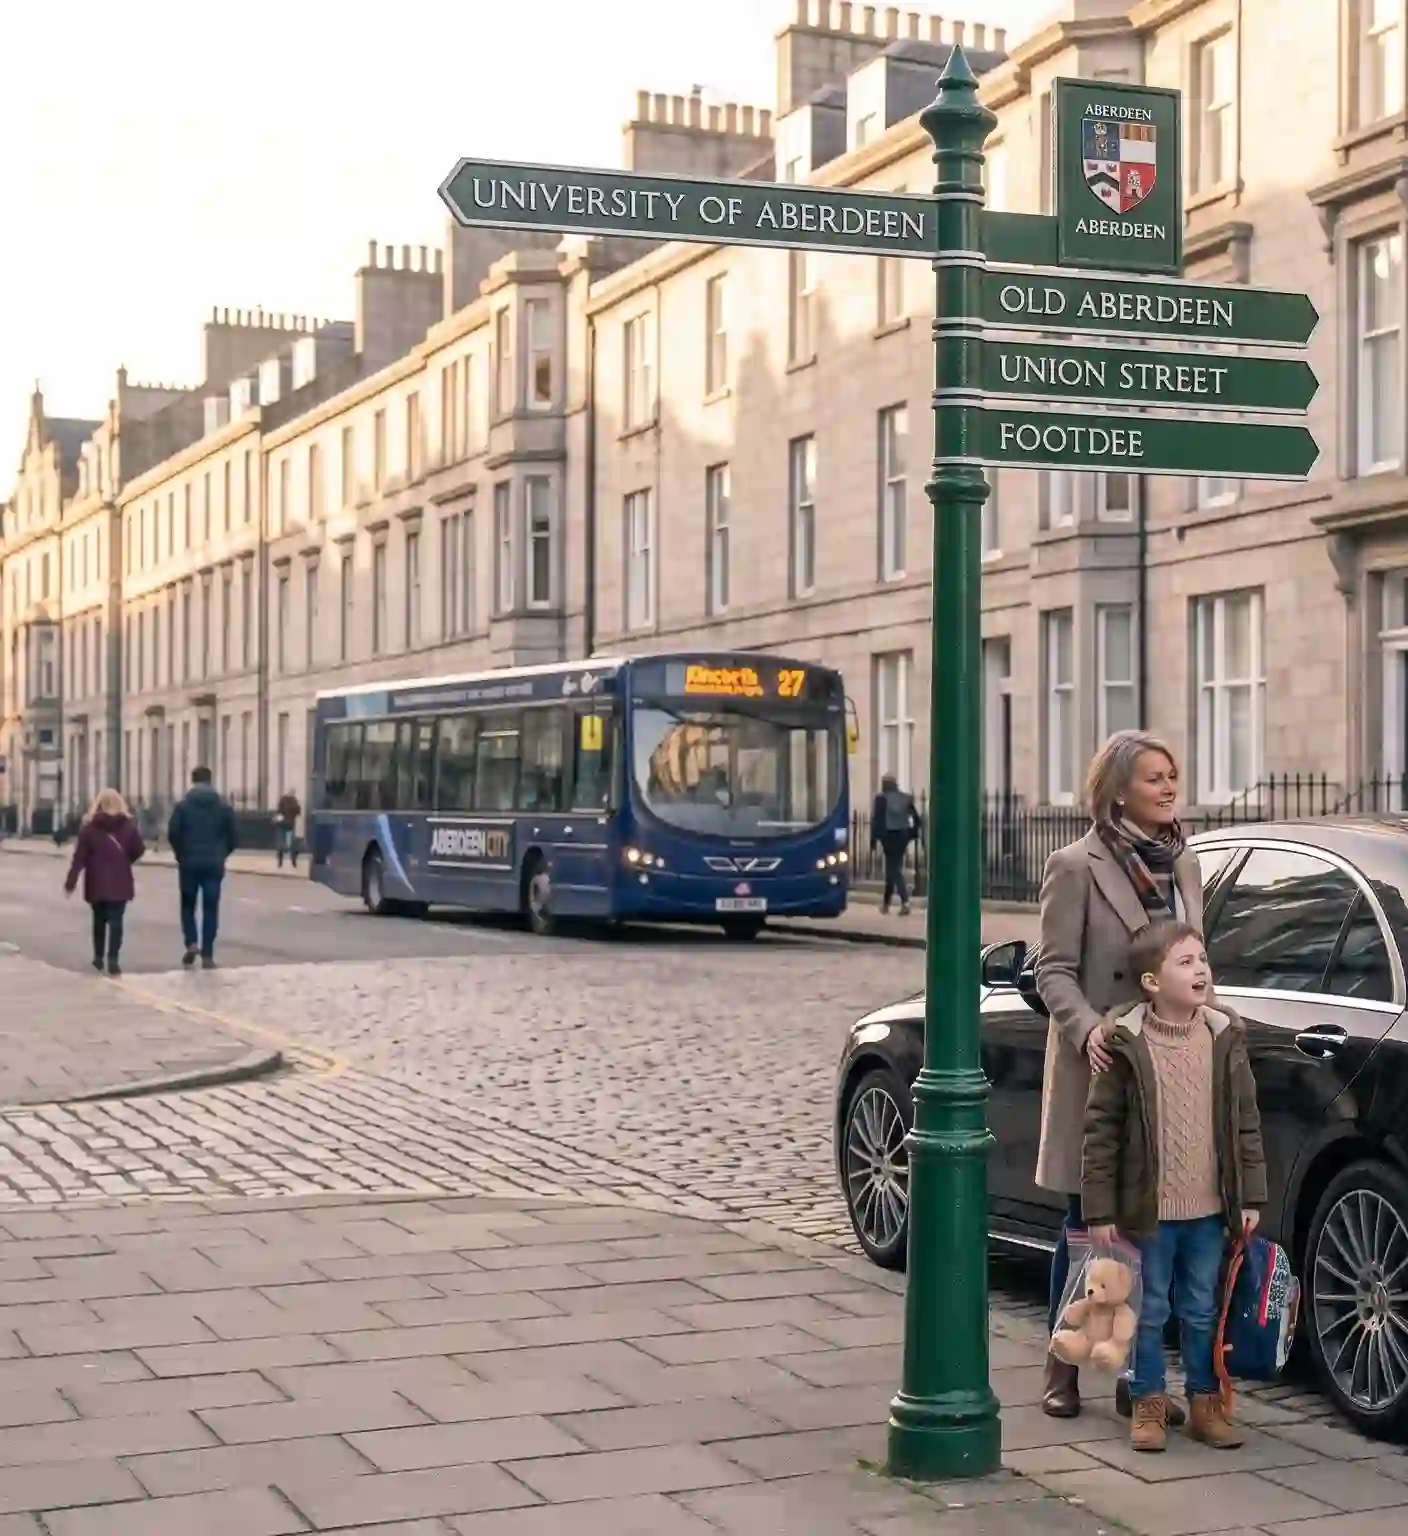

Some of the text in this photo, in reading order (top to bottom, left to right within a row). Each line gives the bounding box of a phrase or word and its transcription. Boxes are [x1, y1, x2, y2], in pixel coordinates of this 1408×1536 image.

[1084, 103, 1152, 121] ABERDEEN
[472, 177, 925, 240] UNIVERSITY OF ABERDEEN
[1075, 217, 1166, 240] ABERDEEN
[999, 285, 1234, 327] OLD ABERDEEN
[999, 354, 1228, 394] UNION STREET
[999, 422, 1144, 457] FOOTDEE
[777, 669, 805, 697] 27
[430, 827, 486, 857] ABERDEEN
